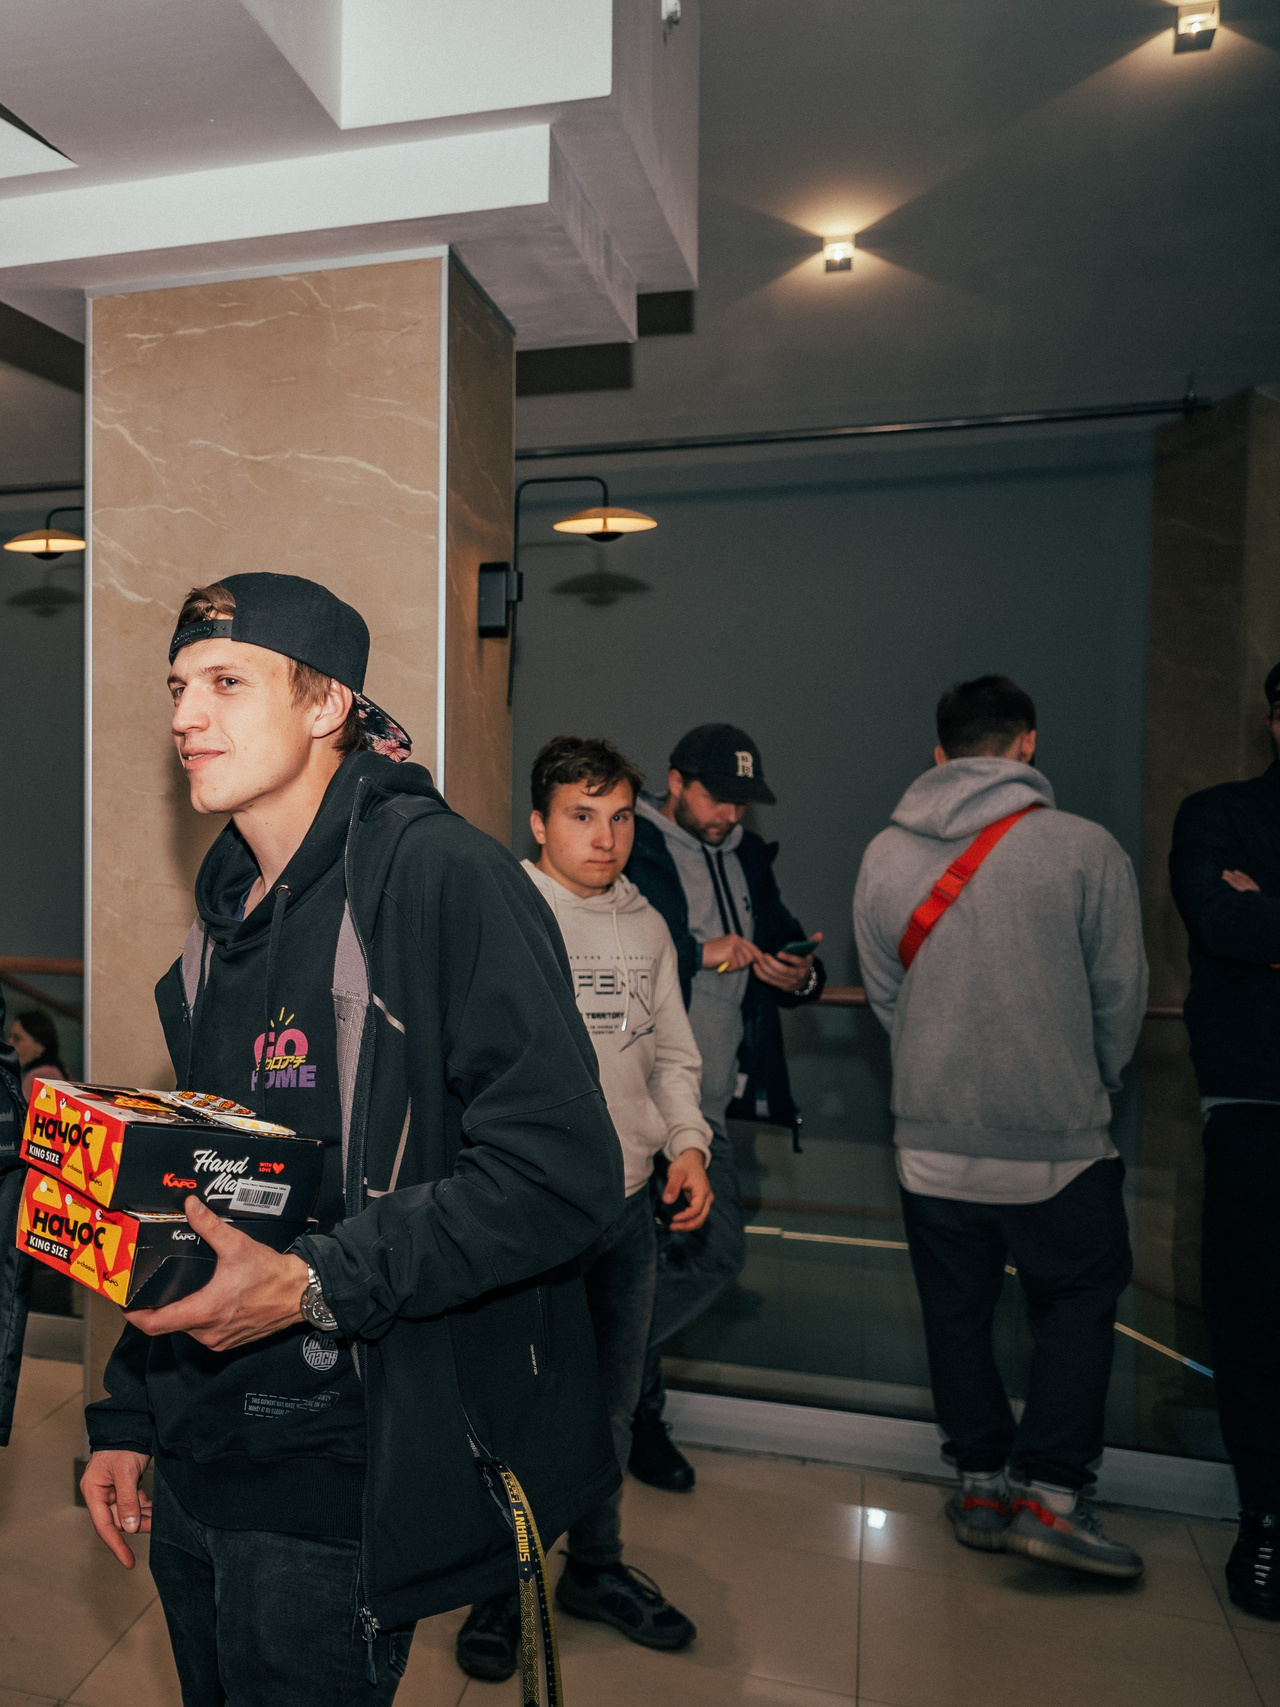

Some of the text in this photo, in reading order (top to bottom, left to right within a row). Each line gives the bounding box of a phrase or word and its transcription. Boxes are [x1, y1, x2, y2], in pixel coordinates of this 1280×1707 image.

[28, 1144, 61, 1165] KING SIZE
[193, 1149, 250, 1174] Hand
[204, 1173, 253, 1197] Ma
[29, 1235, 69, 1259] KING SIZE
[513, 1508, 531, 1562] SMOANT
